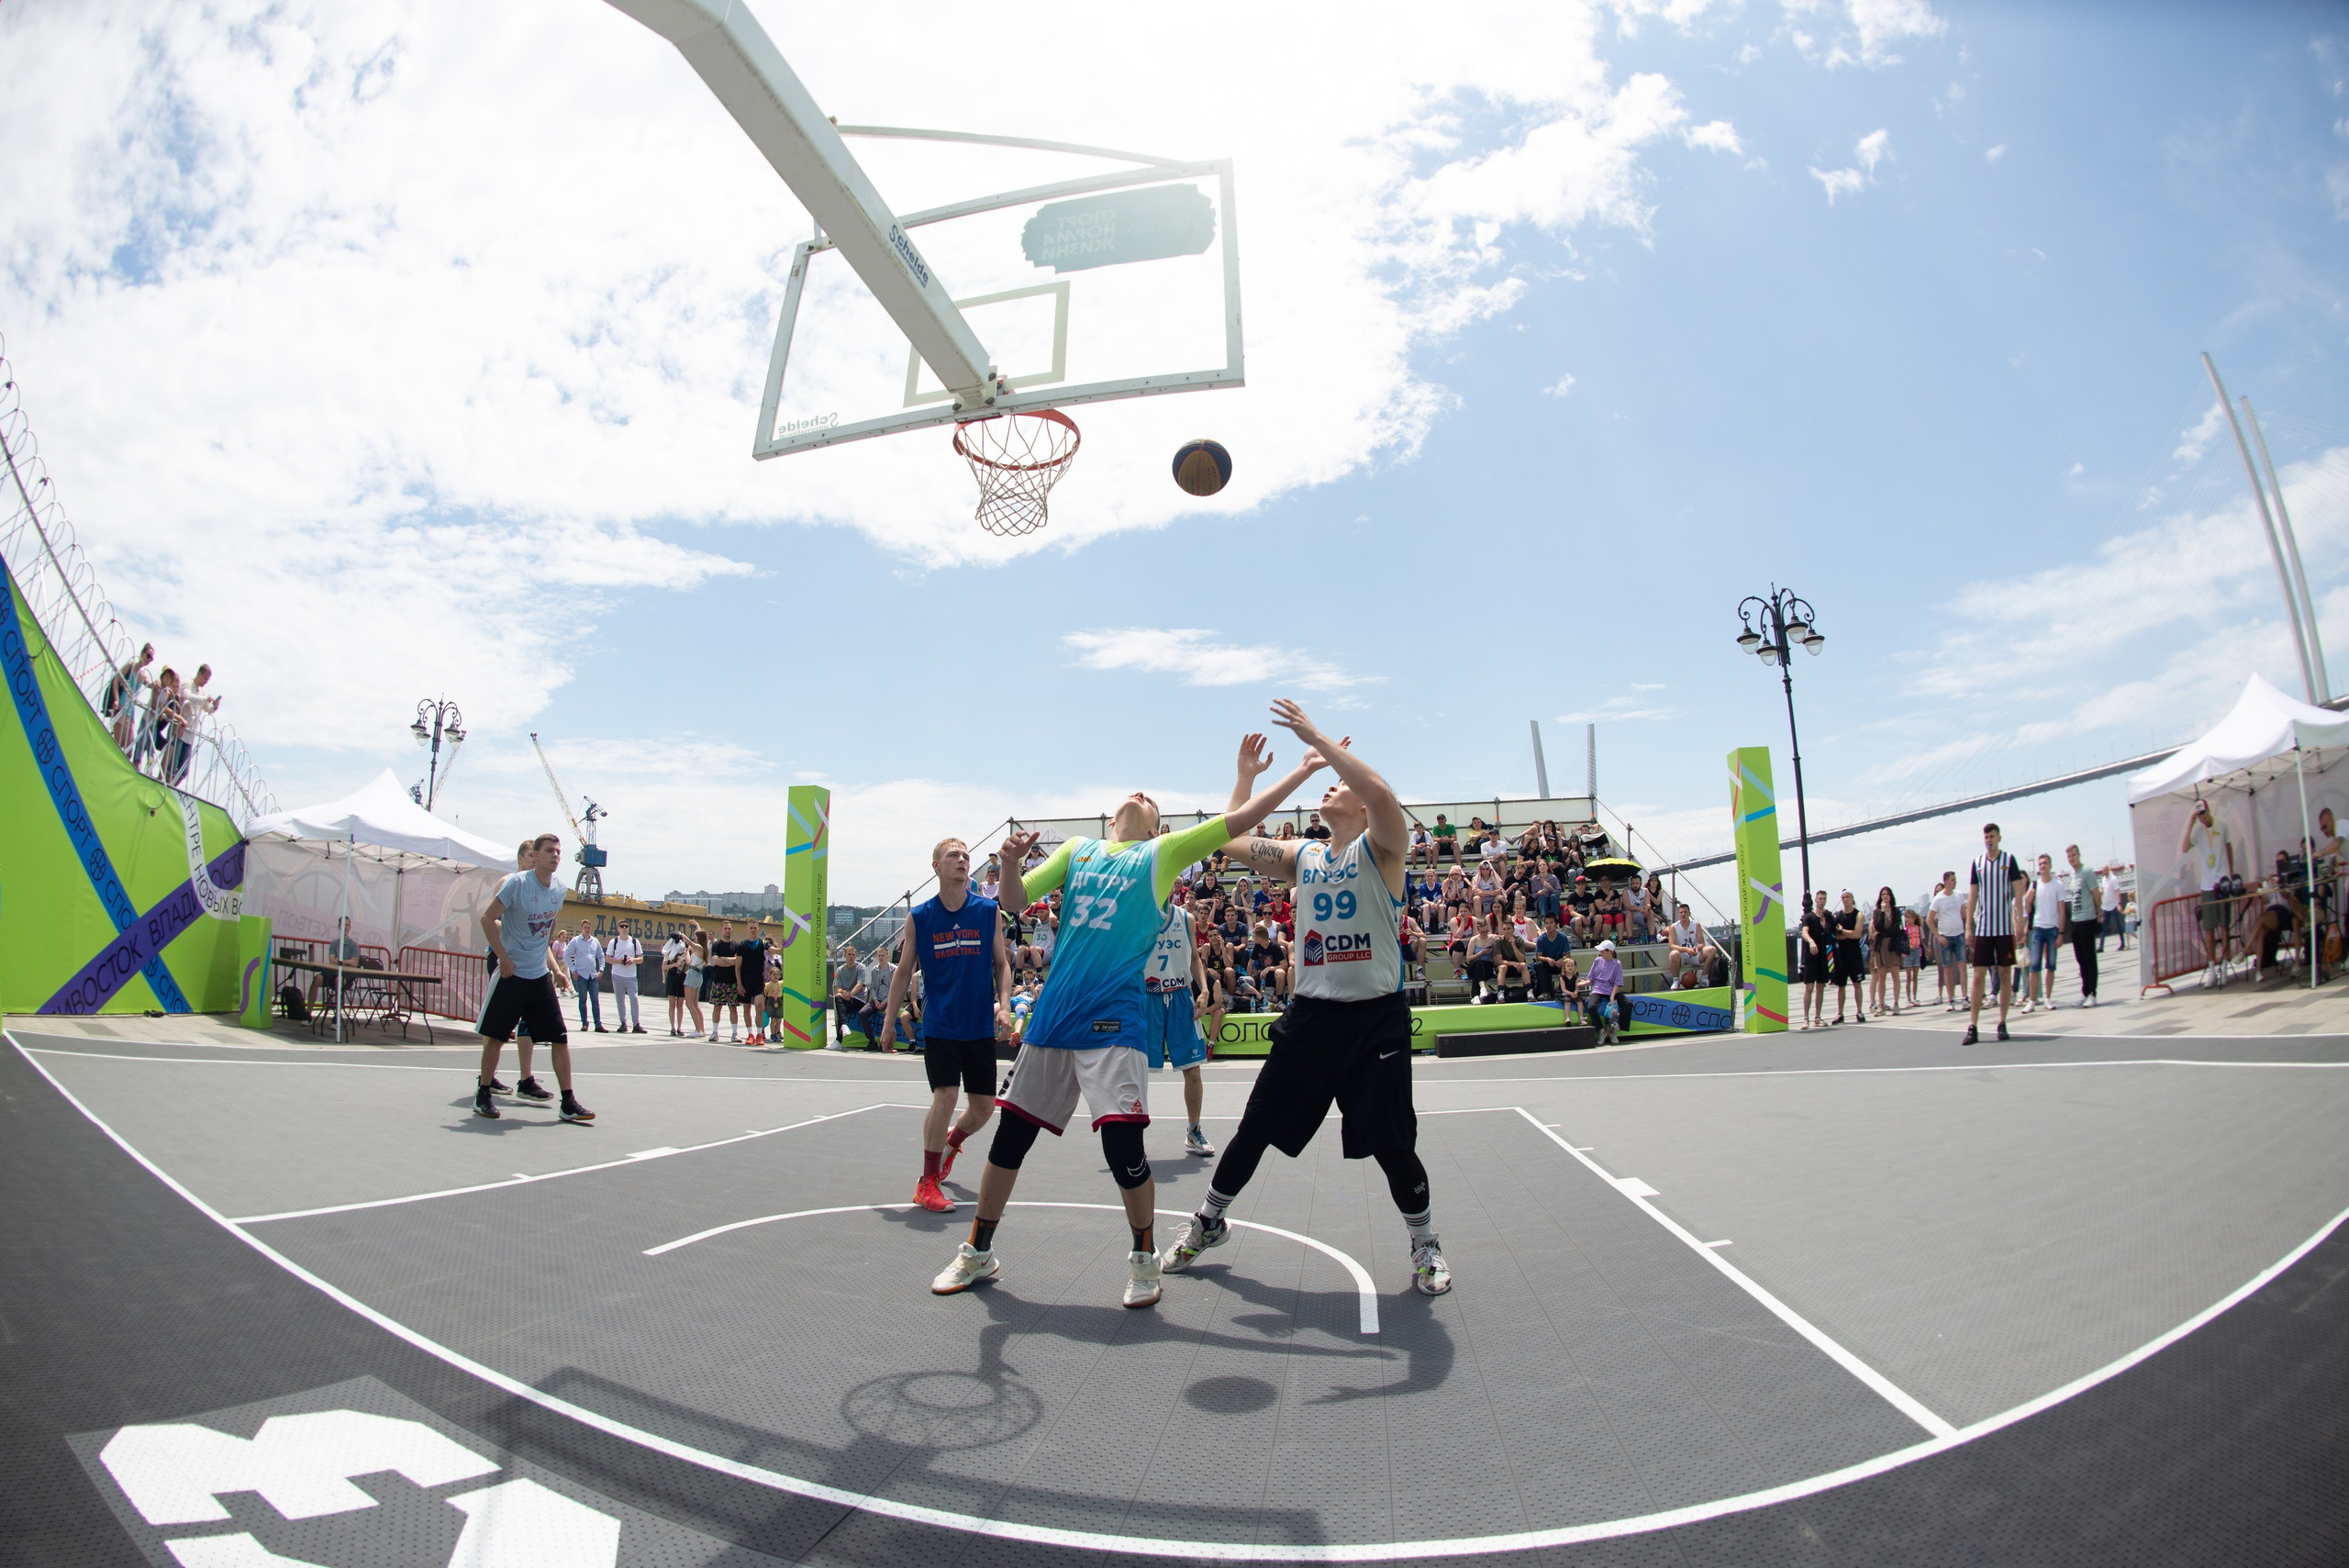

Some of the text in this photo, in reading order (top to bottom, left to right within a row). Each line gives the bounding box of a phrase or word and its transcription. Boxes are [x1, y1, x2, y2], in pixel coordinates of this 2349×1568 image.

[888, 224, 929, 284] Schelde
[4, 629, 42, 725] СПОРТ
[51, 765, 93, 848] СПОРТ
[194, 863, 229, 915] НОВЫХ
[1070, 871, 1137, 892] ДГТРУ
[106, 880, 138, 930] СПО
[1069, 895, 1118, 930] 32
[1313, 889, 1357, 922] 99
[932, 929, 981, 943] NEW YORK
[1036, 933, 1048, 941] 30
[1325, 932, 1371, 951] CDM
[934, 947, 982, 960] BASKETBALL
[1157, 954, 1169, 972] 7
[1327, 951, 1371, 962] GROUP LLC
[1743, 938, 1752, 966] ДЕНЬ
[1162, 977, 1185, 988] CDM
[1631, 1000, 1732, 1029] ОРТ СПО
